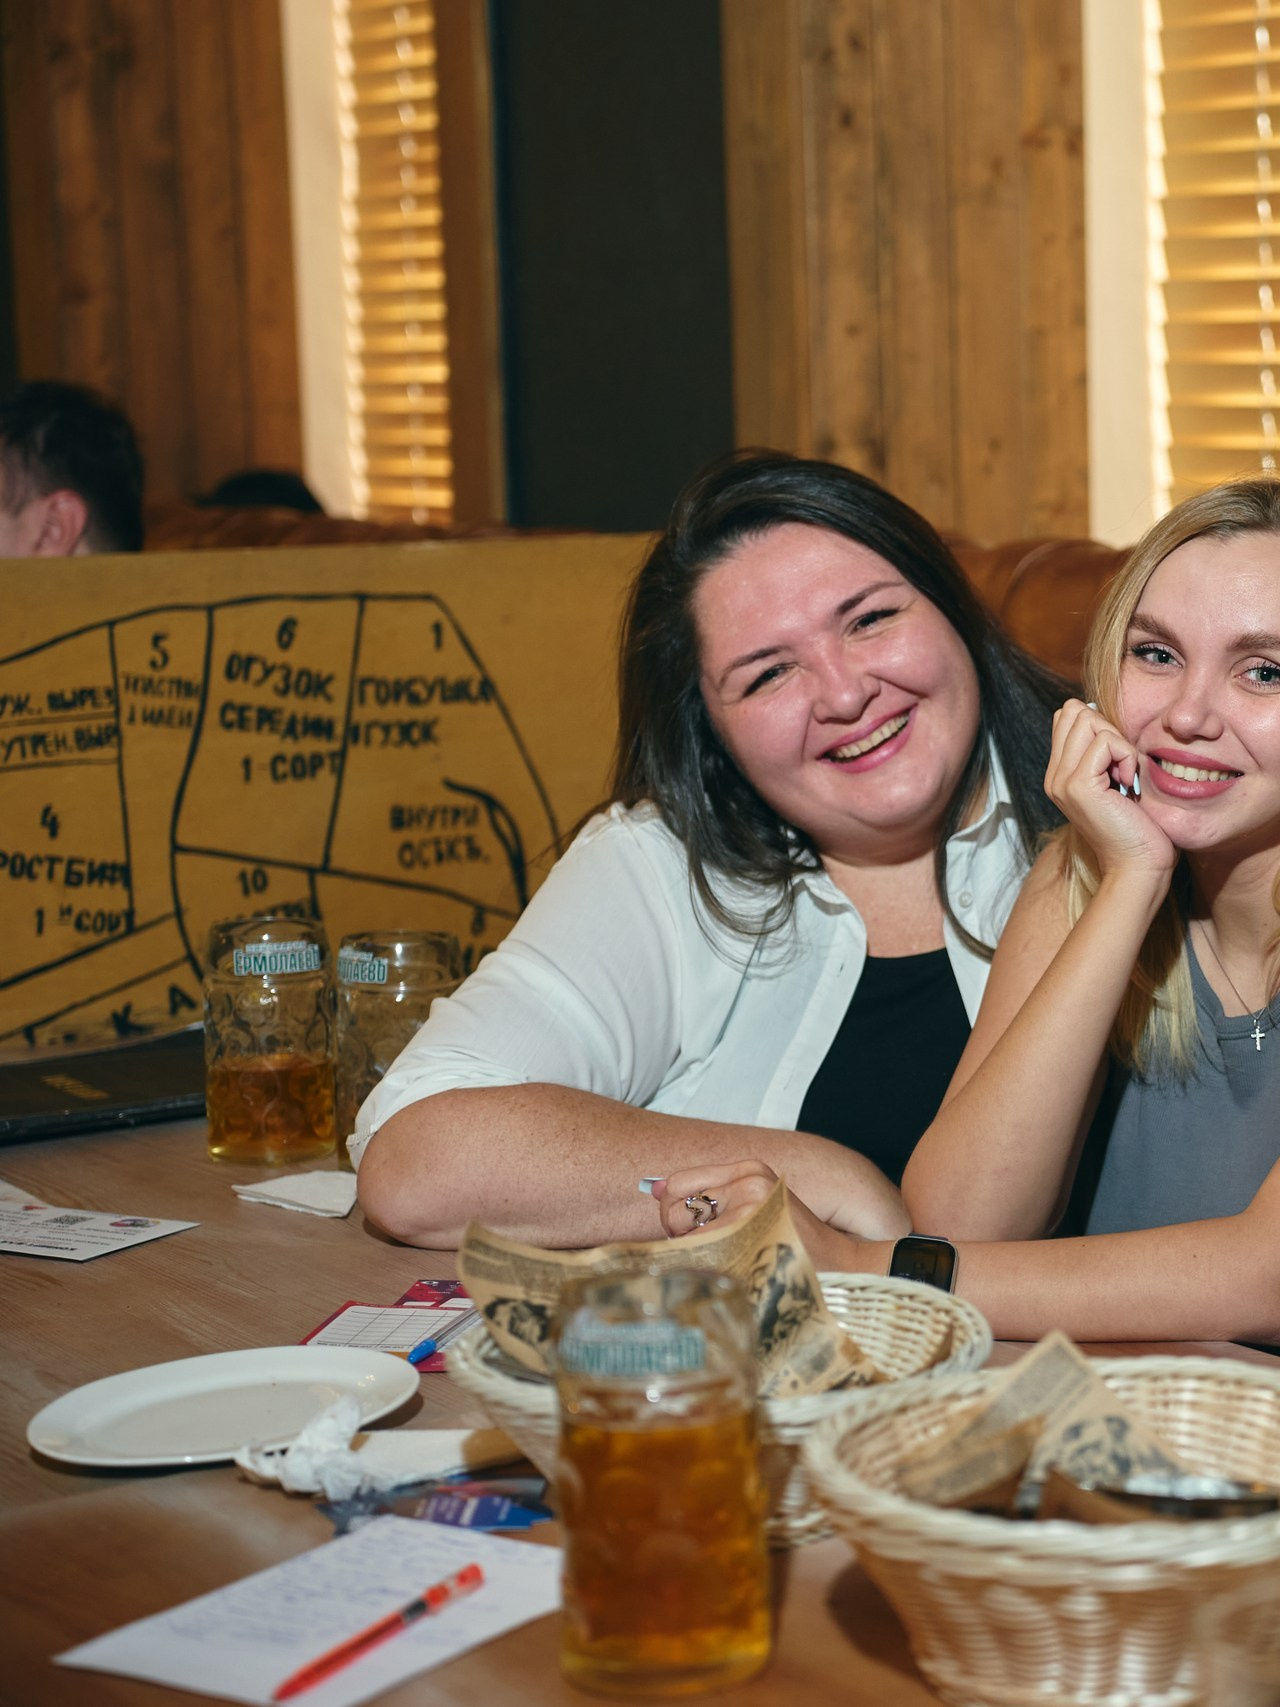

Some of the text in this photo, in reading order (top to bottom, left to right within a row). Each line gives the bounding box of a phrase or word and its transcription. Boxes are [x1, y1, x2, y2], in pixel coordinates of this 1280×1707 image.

[148, 631, 170, 671] 5
[277, 614, 299, 651] 6
[432, 619, 443, 651] 1
[224, 652, 335, 704] ОГУЗОК
[41, 803, 60, 840] 4
[239, 867, 269, 898] 10
